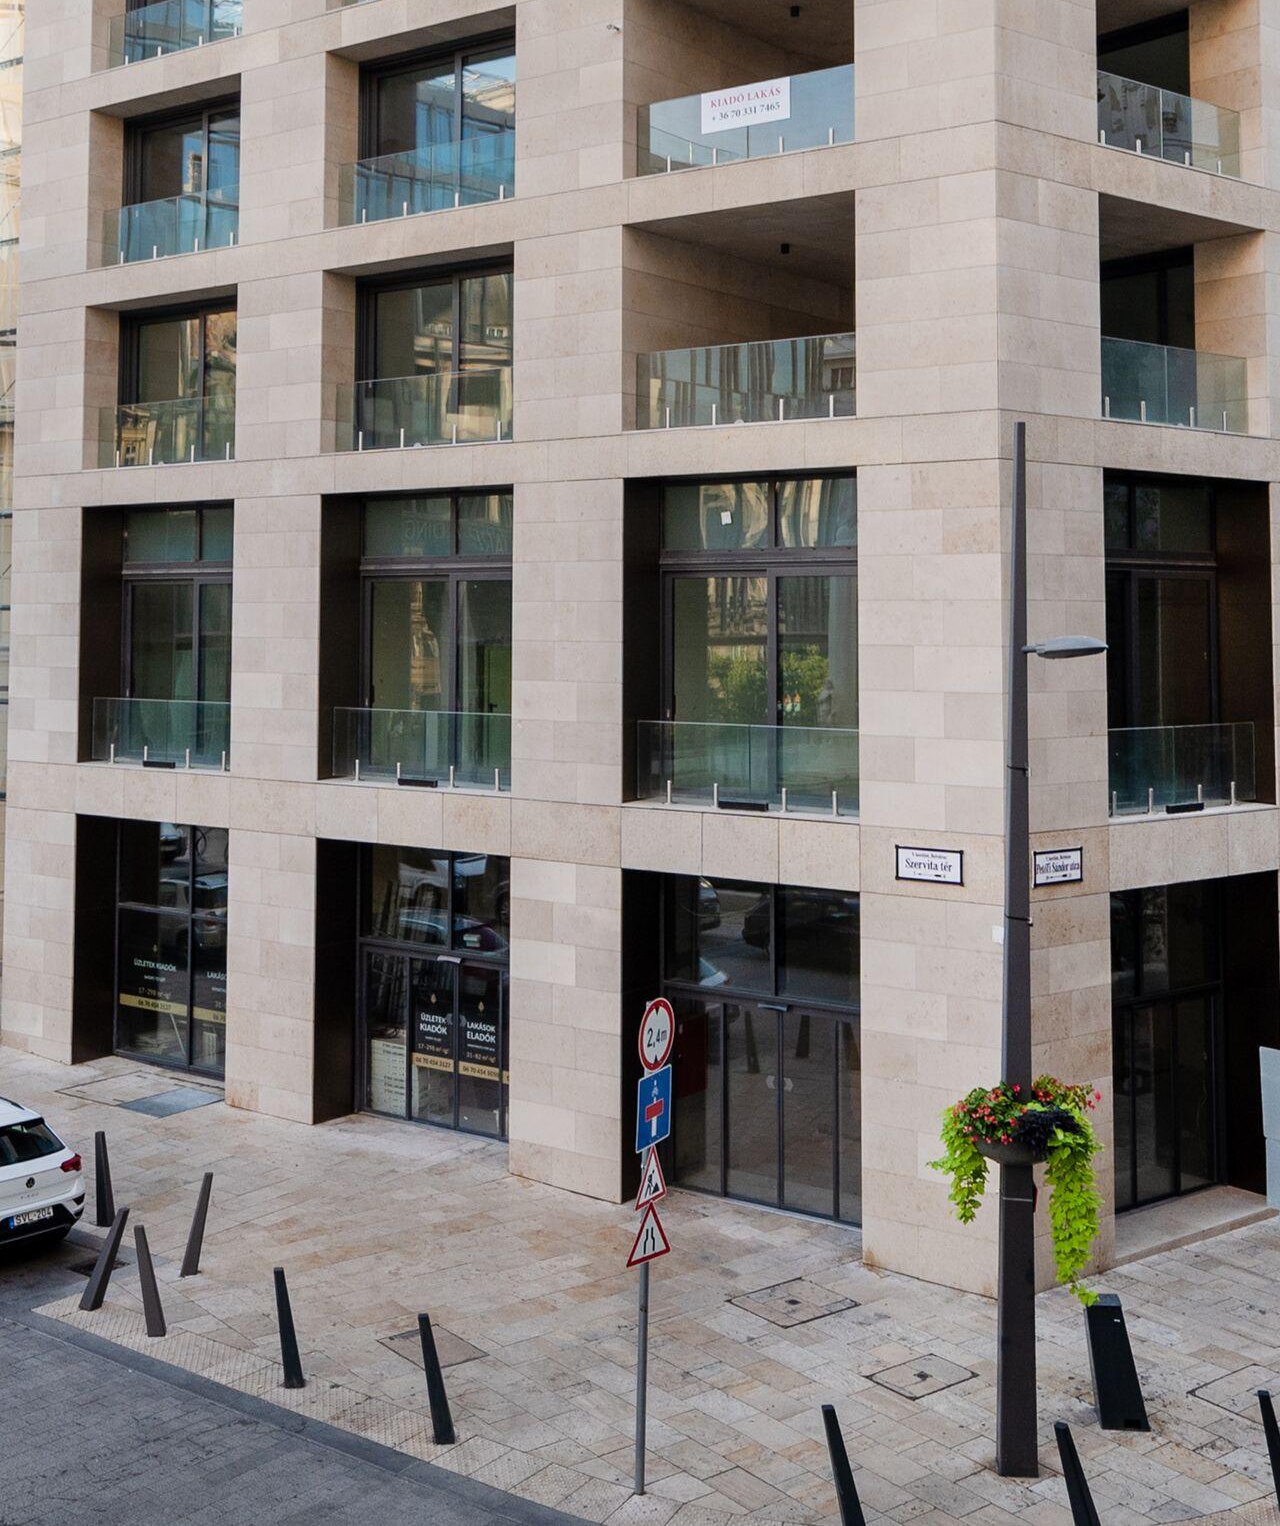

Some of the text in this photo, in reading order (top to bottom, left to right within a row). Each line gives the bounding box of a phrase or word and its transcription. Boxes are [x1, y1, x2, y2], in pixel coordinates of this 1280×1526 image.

[905, 857, 953, 872] Szervita tér
[420, 1012, 447, 1024] ÜZLETEK
[420, 1023, 448, 1035] KIADÓK
[467, 1021, 496, 1033] LAKÁSOK
[467, 1031, 496, 1043] ELADÓK
[646, 1027, 668, 1049] 2,4m
[16, 1207, 54, 1225] SVL-204
